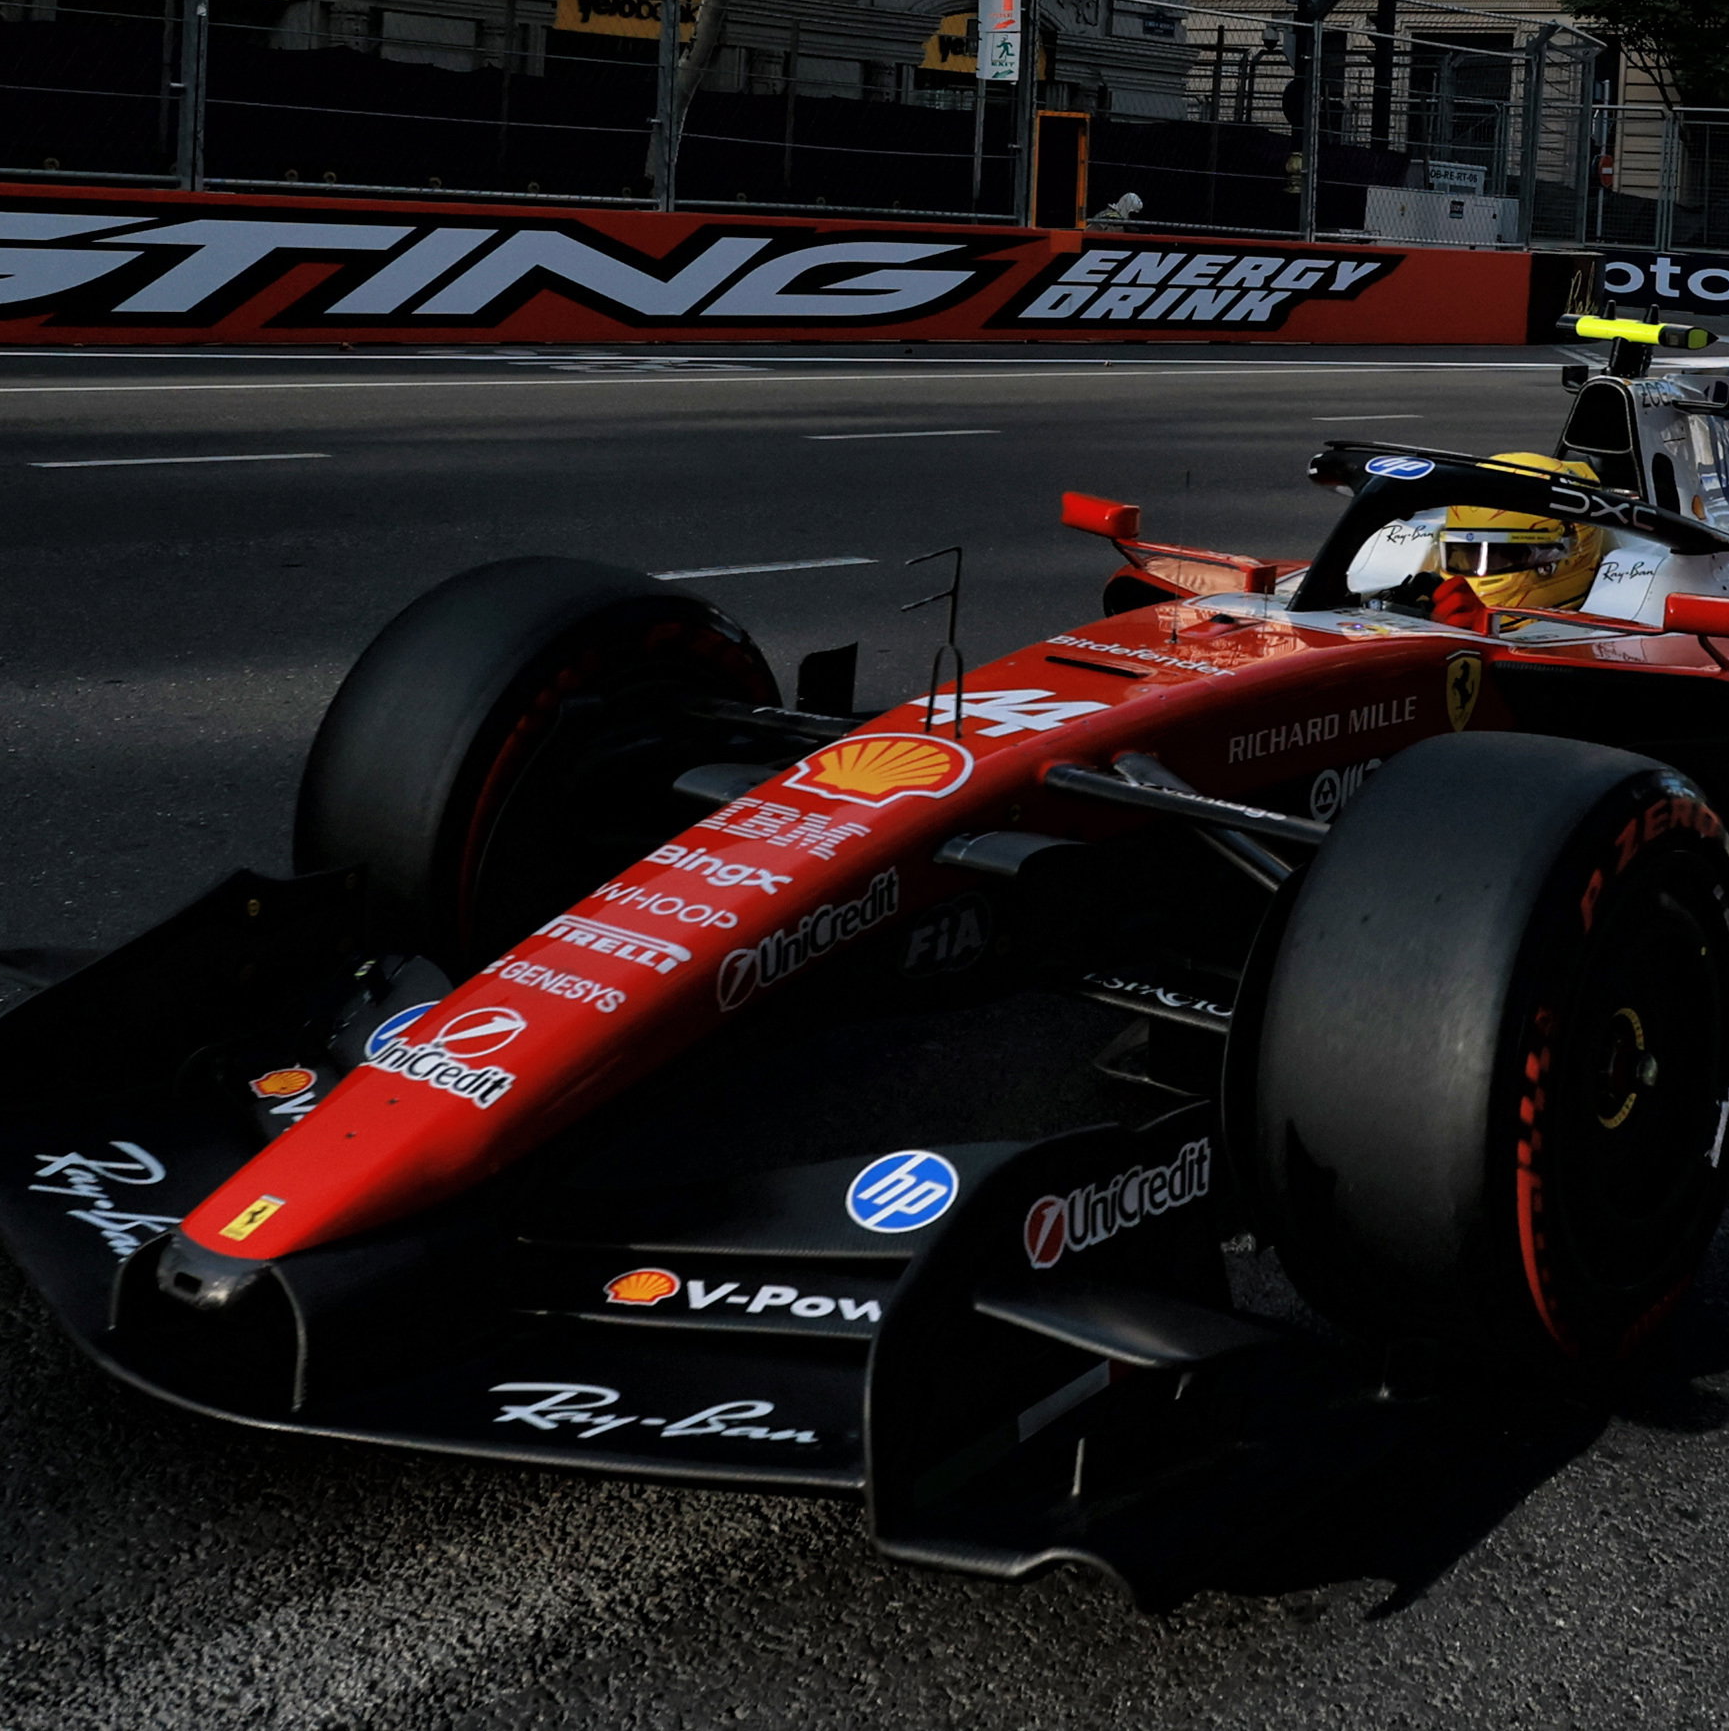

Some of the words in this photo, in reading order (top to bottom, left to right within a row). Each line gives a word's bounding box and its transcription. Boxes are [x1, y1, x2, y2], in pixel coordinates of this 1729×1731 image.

[1057, 249, 1383, 291] ENERGY
[1017, 284, 1293, 322] DRINK
[1383, 524, 1434, 542] Ray-Ban
[1549, 486, 1657, 531] DXC
[1601, 561, 1655, 582] Ray-Ban
[1046, 634, 1237, 676] Bitdefender
[907, 688, 1114, 738] 44
[1228, 712, 1340, 765] RICHARD
[1347, 695, 1418, 735] MILLE
[692, 797, 872, 862] IBM
[589, 882, 739, 931] WHOOP
[756, 866, 901, 987] UniCredit
[535, 914, 694, 975] PIRELLI
[499, 959, 628, 1014] GENESYS
[855, 1150, 950, 1231] hp
[1066, 1136, 1212, 1251] UniCredit
[488, 1381, 822, 1444] Ray-Ban
